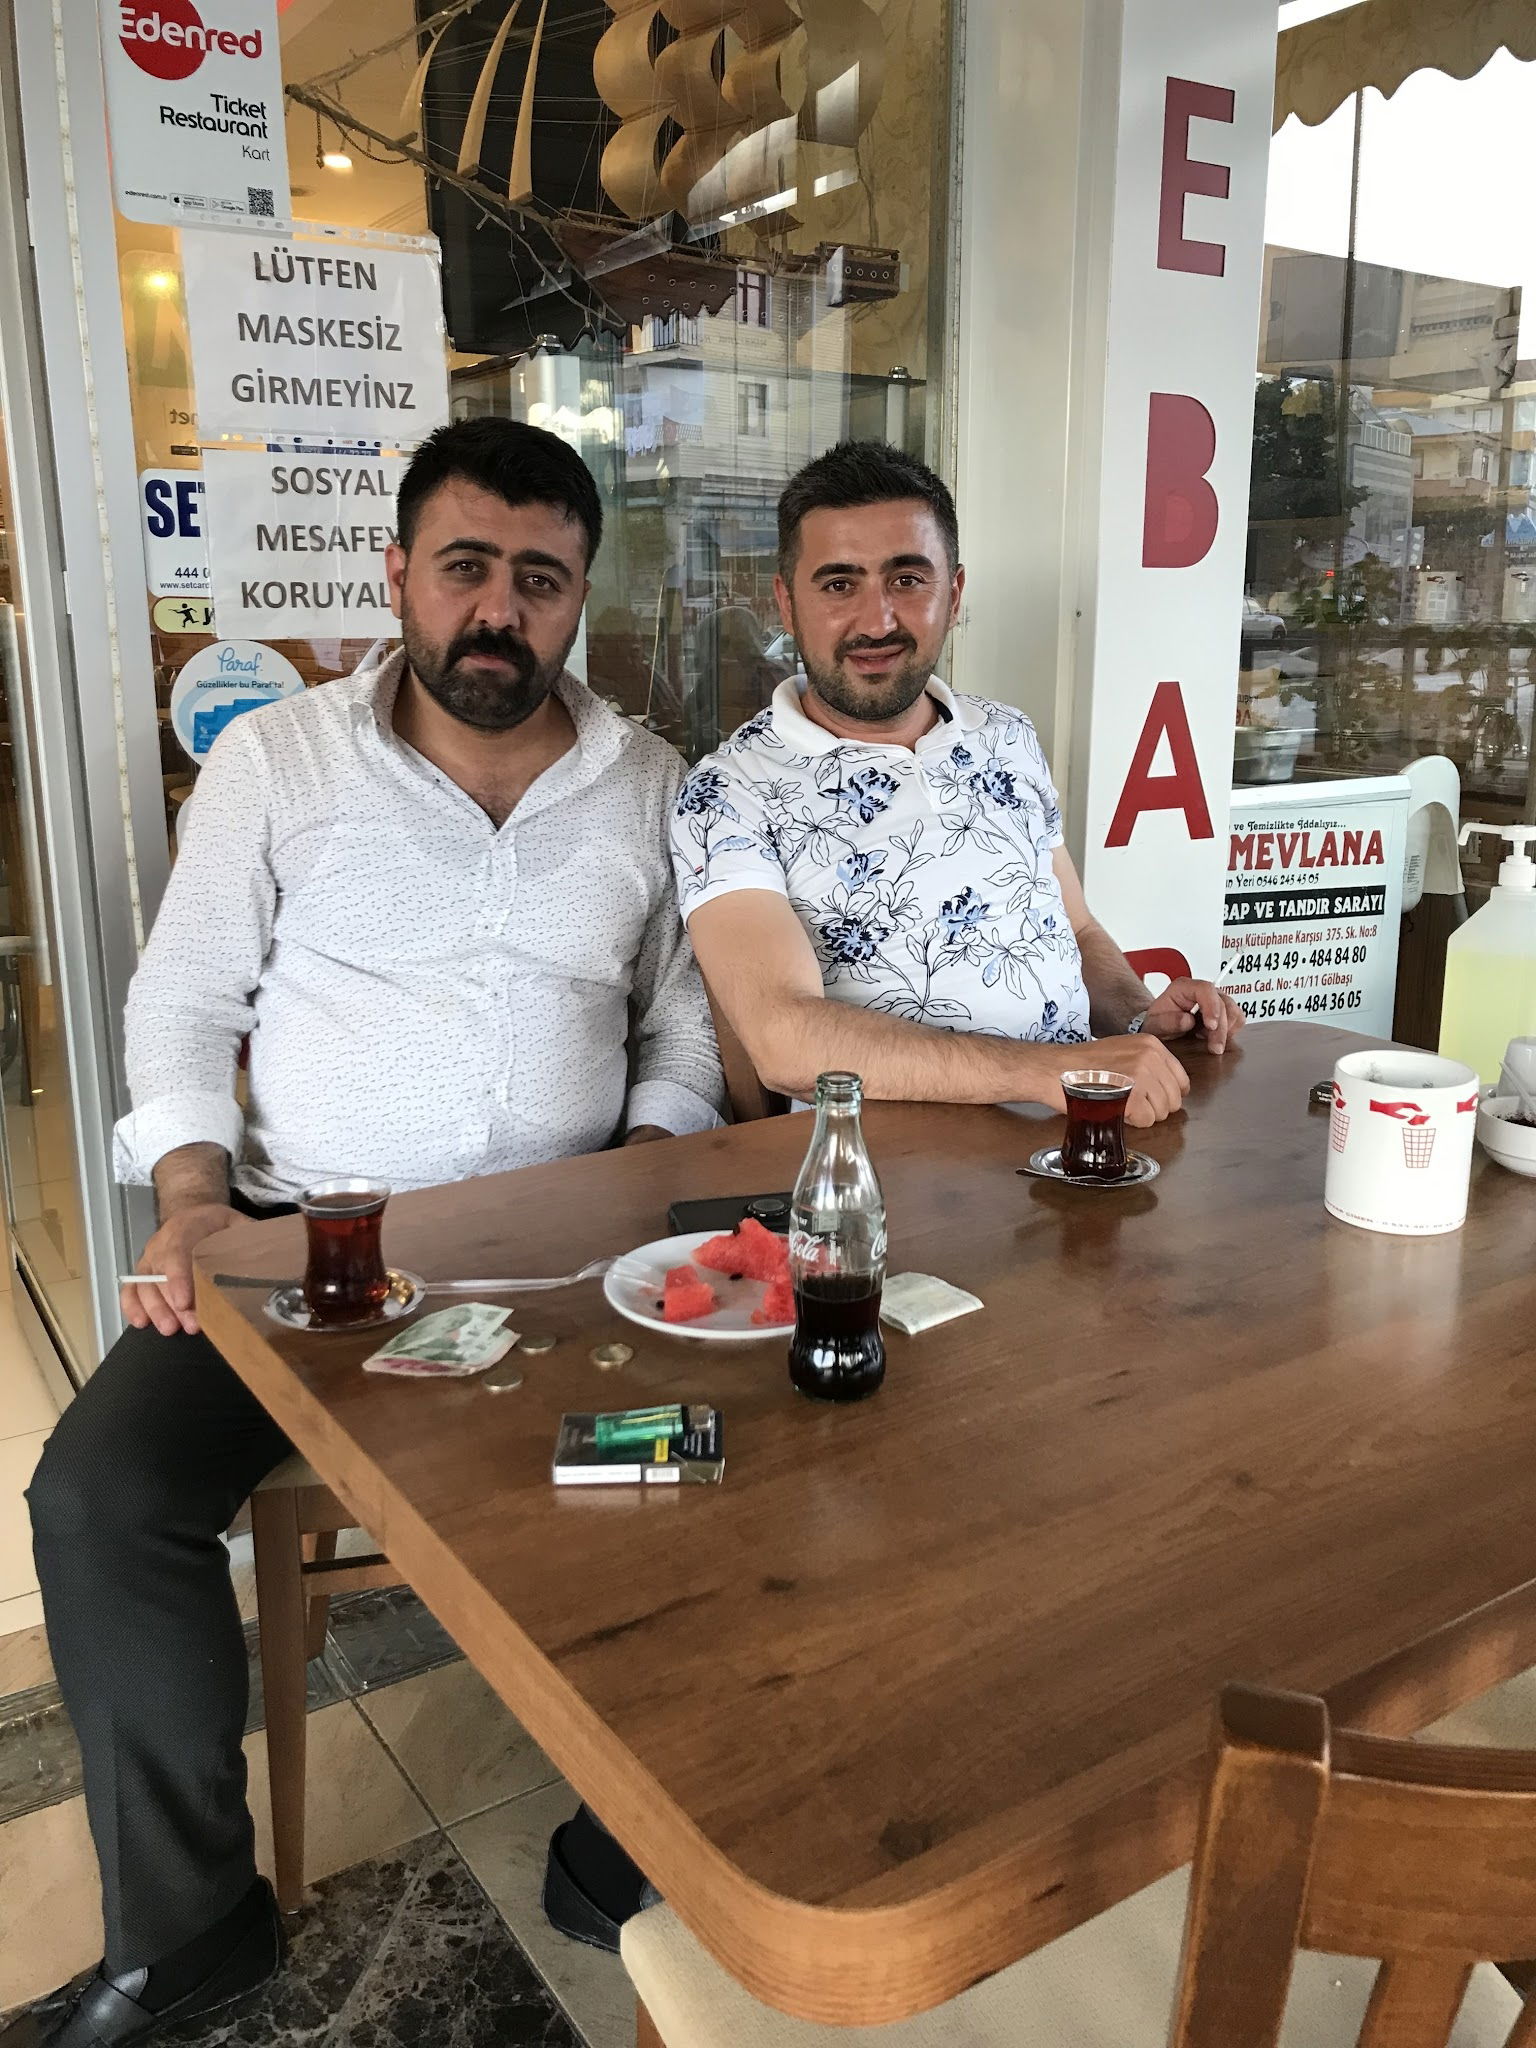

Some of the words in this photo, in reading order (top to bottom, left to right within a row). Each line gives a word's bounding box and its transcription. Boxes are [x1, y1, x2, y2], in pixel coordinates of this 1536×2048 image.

[119, 6, 262, 58] Edenred
[210, 94, 266, 119] Ticket
[159, 105, 268, 139] Restaurant
[242, 145, 270, 161] Kart
[254, 246, 377, 290] LÜTFEN
[237, 313, 402, 351] MASKESİZ
[231, 368, 416, 409] GİRMEYİNZ
[271, 466, 393, 496] SOSYAL
[145, 479, 205, 537] SE
[175, 567, 199, 579] 444
[241, 581, 391, 608] KORUYAL
[217, 647, 263, 676] Paraf
[196, 680, 237, 689] Güzellikler
[239, 681, 249, 689] bu
[1234, 822, 1244, 831] ve
[1247, 820, 1294, 832] Temizlikte
[1227, 830, 1384, 871] MEVLANA
[1236, 873, 1254, 888] Yeri
[1257, 875, 1277, 887] 0546
[1280, 874, 1294, 886] 245
[1297, 873, 1306, 885] 45
[1309, 873, 1319, 884] 05
[1254, 901, 1274, 919] VE
[1279, 898, 1329, 917] TANDIR
[1334, 894, 1384, 914] SARAYI
[1245, 931, 1293, 949] Kütüphane
[1295, 930, 1322, 945] Karşısı
[1326, 928, 1343, 941] 375.
[1346, 926, 1356, 939] Sk.
[1360, 924, 1377, 938] No:8
[1237, 953, 1261, 974] 484
[1264, 952, 1279, 971] 43
[1282, 951, 1298, 970] 49
[1309, 948, 1331, 967] 484
[1334, 947, 1349, 965] 84
[1352, 945, 1366, 963] 80
[1254, 978, 1273, 993] Cad.
[1277, 977, 1292, 990] No:
[1294, 975, 1318, 990] 41/11
[1322, 973, 1353, 988] Gölbaşı
[1237, 1001, 1256, 1019] 84
[1259, 999, 1275, 1018] 56
[1278, 997, 1294, 1016] 46
[1305, 995, 1327, 1013] 484
[1330, 992, 1345, 1010] 36
[1347, 990, 1362, 1008] 05
